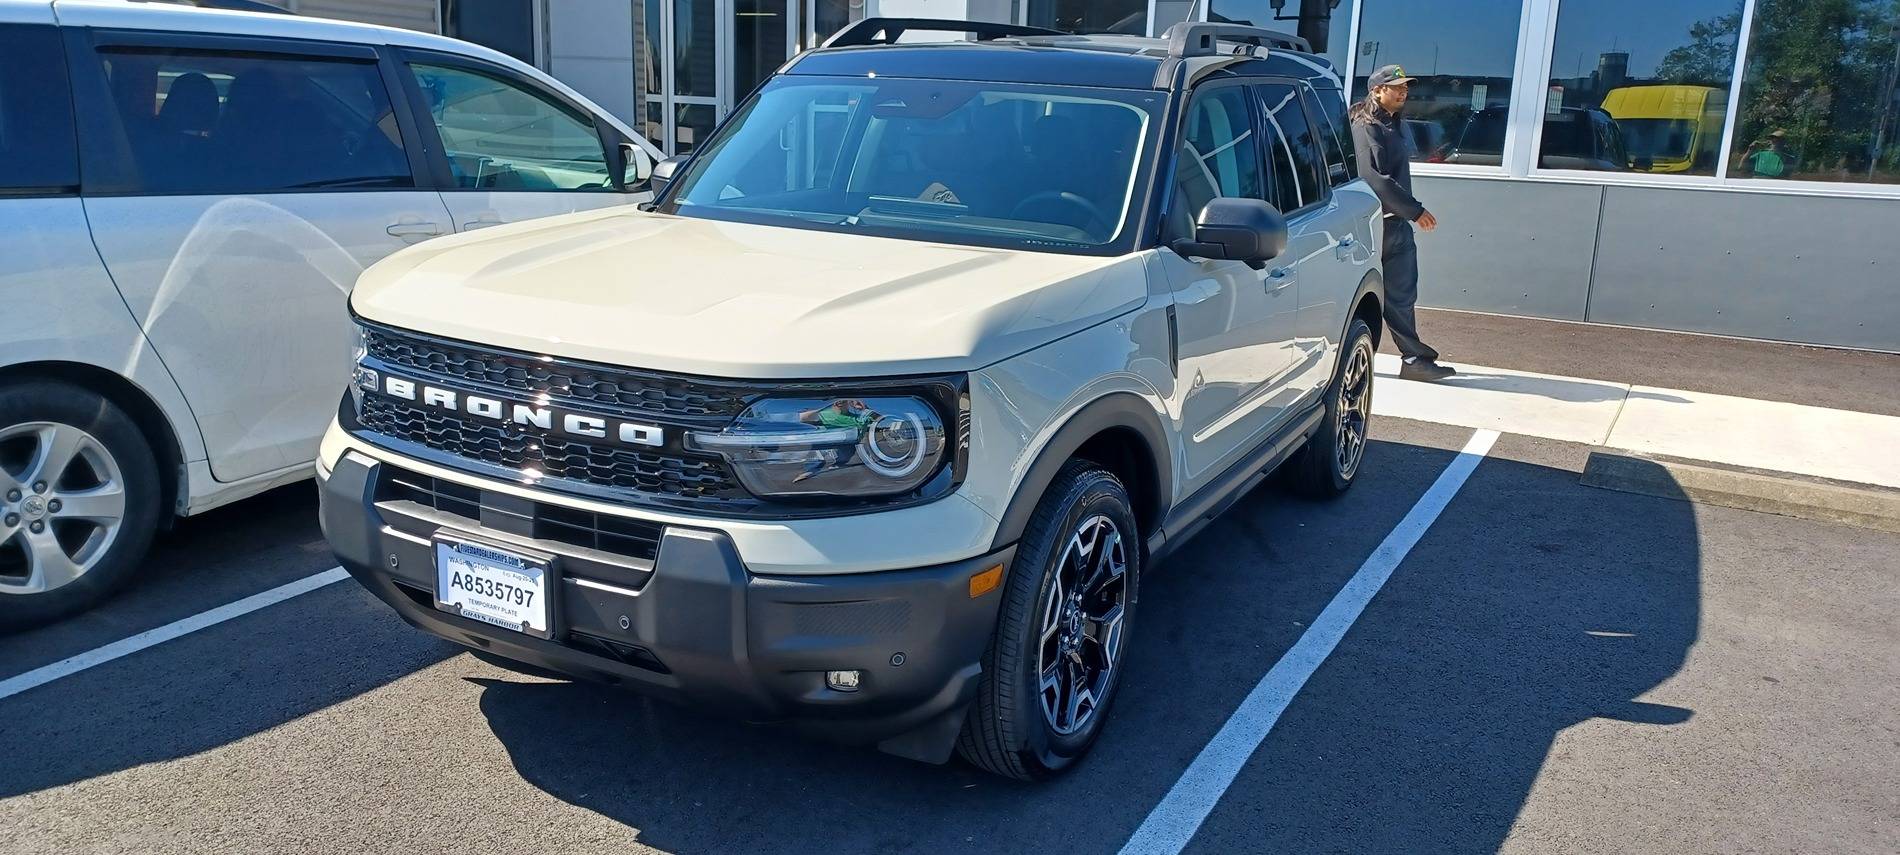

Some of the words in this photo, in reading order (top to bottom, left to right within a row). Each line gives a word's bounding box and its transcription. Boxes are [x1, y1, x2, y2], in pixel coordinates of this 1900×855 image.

[386, 376, 664, 447] BRONCO
[448, 556, 490, 571] WASHINGTON
[451, 571, 534, 608] A8535797
[468, 598, 501, 611] TEMPORARY
[501, 607, 518, 617] PLATE
[488, 617, 520, 630] HARBOR
